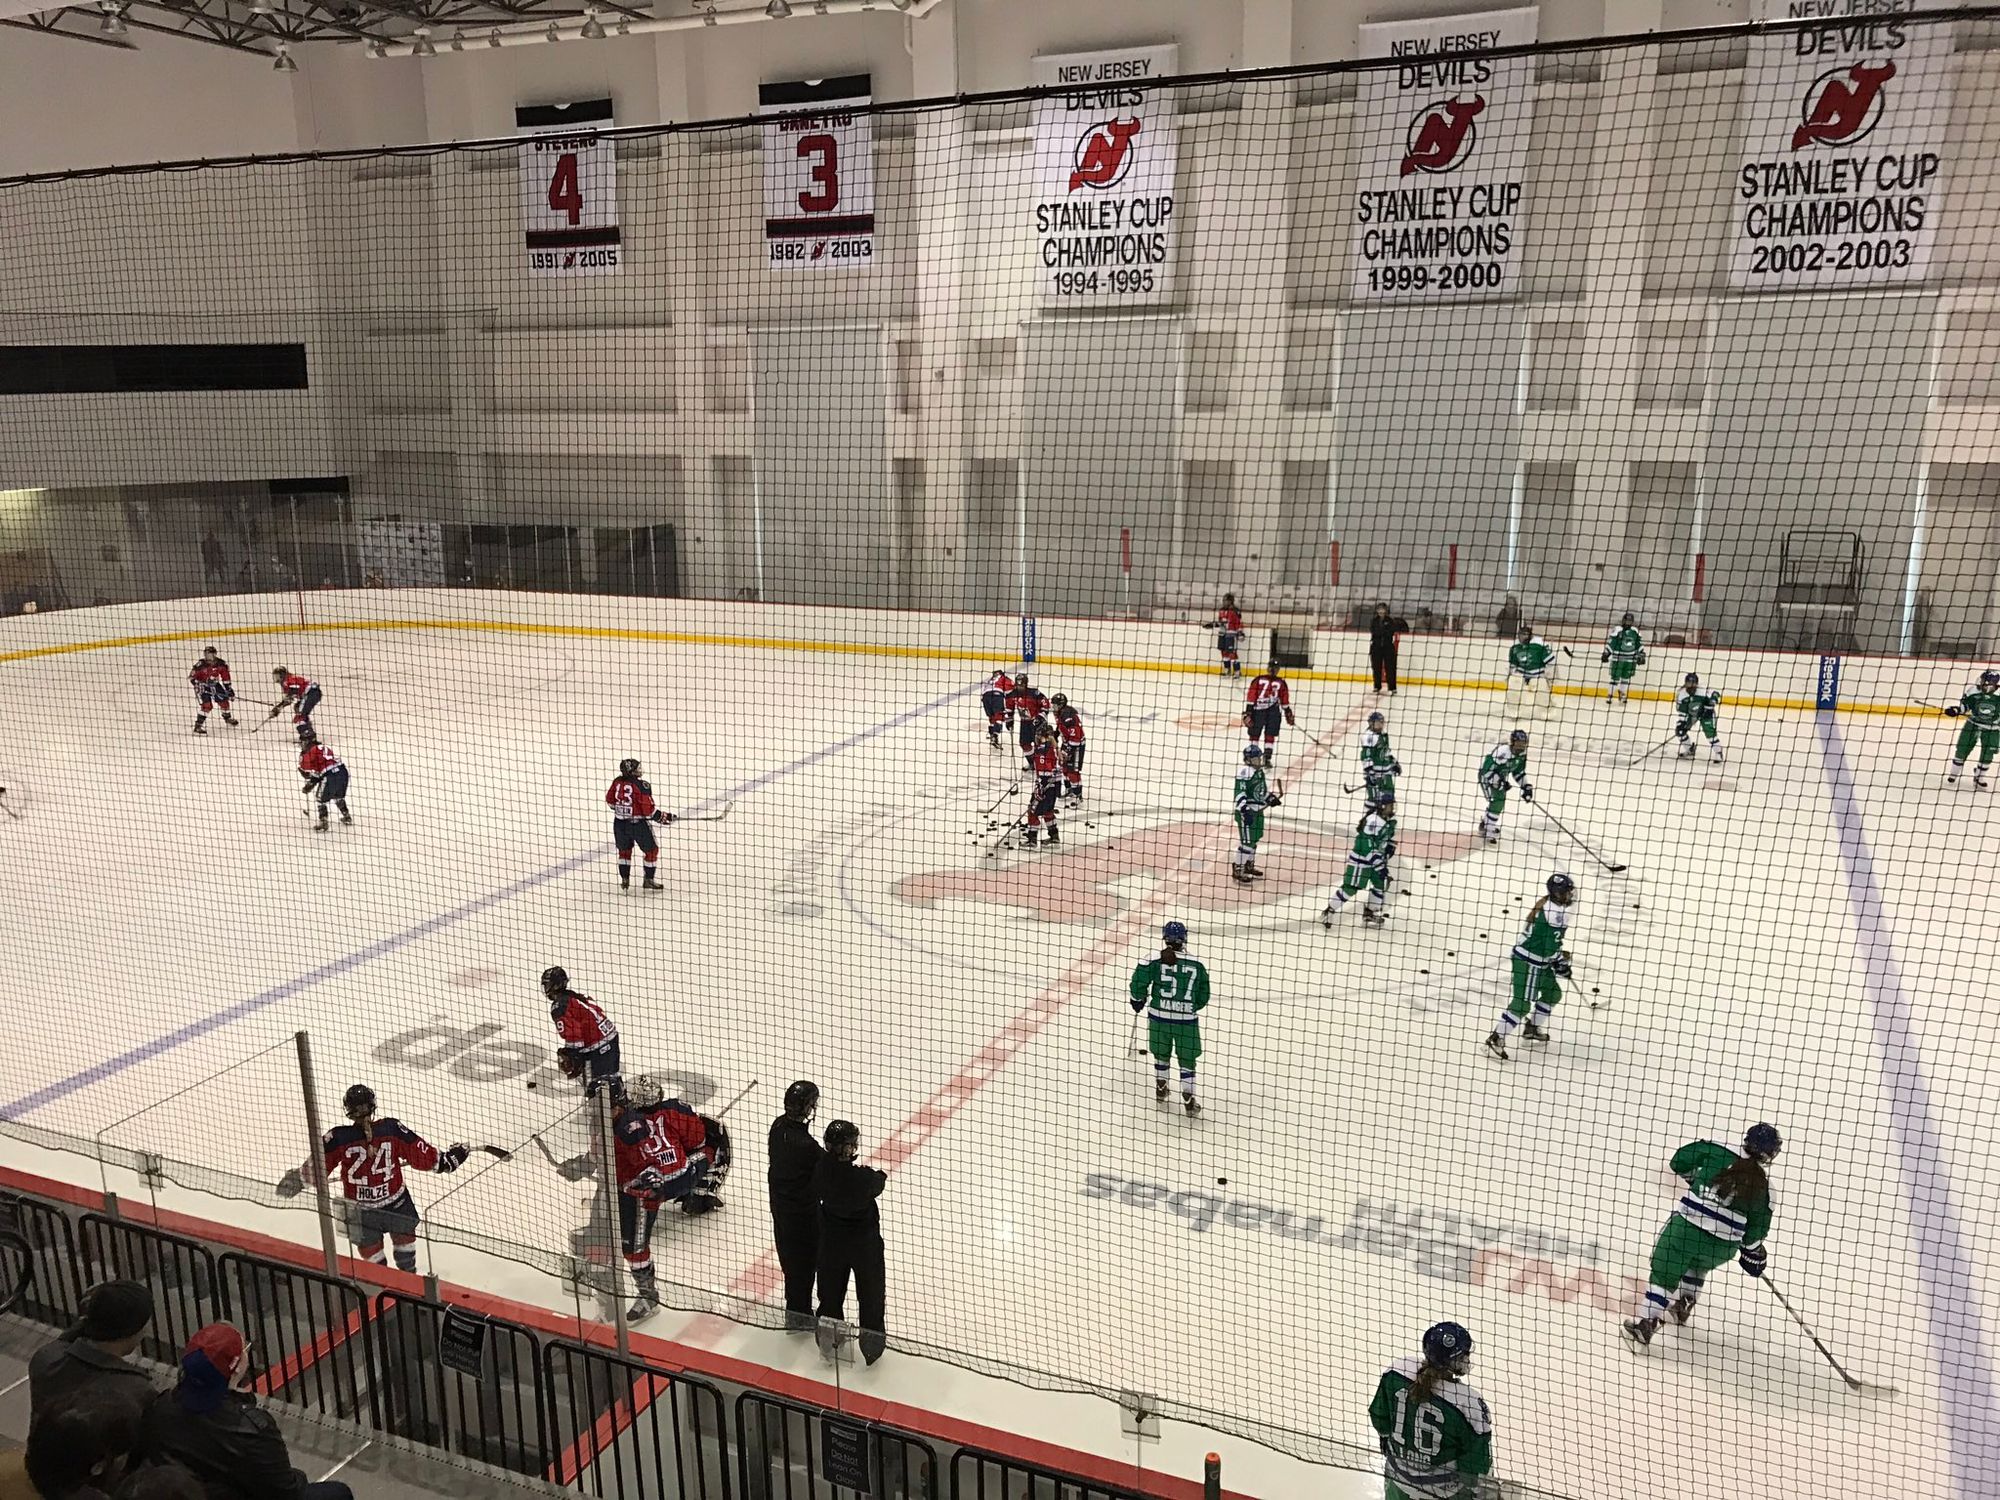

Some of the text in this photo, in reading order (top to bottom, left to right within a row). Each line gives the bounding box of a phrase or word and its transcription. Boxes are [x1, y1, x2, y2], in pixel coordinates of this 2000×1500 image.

[1391, 30, 1501, 57] NEW JERSEY
[1795, 24, 1906, 56] DEVILS
[1058, 59, 1151, 83] NEW JERSEY
[1399, 59, 1491, 90] DEVILS
[1066, 87, 1143, 111] DEVILS
[548, 153, 584, 225] 4
[796, 134, 839, 213] 3
[1741, 153, 1940, 199] STANLEY CUP
[1036, 196, 1173, 233] STANLEY CUP
[1358, 183, 1522, 222] STANLEY CUP
[1746, 196, 1925, 239] CHAMPIONS
[531, 252, 560, 269] 1991
[579, 250, 618, 268] 2005
[770, 243, 805, 261] 1982
[831, 240, 873, 259] 2003
[1043, 232, 1166, 268] CHAMPIONS
[1363, 222, 1511, 261] CHAMPIONS
[1752, 239, 1911, 274] 2002-2003
[1053, 269, 1154, 296] 1994-1995
[1368, 262, 1502, 291] 1999-2000
[1024, 618, 1034, 656] Reebok
[1258, 679, 1281, 699] 73
[1820, 656, 1837, 702] Reebok
[614, 783, 633, 806] 13
[1159, 963, 1198, 1001] 57
[345, 1141, 396, 1186] 24
[1391, 1387, 1445, 1457] 16
